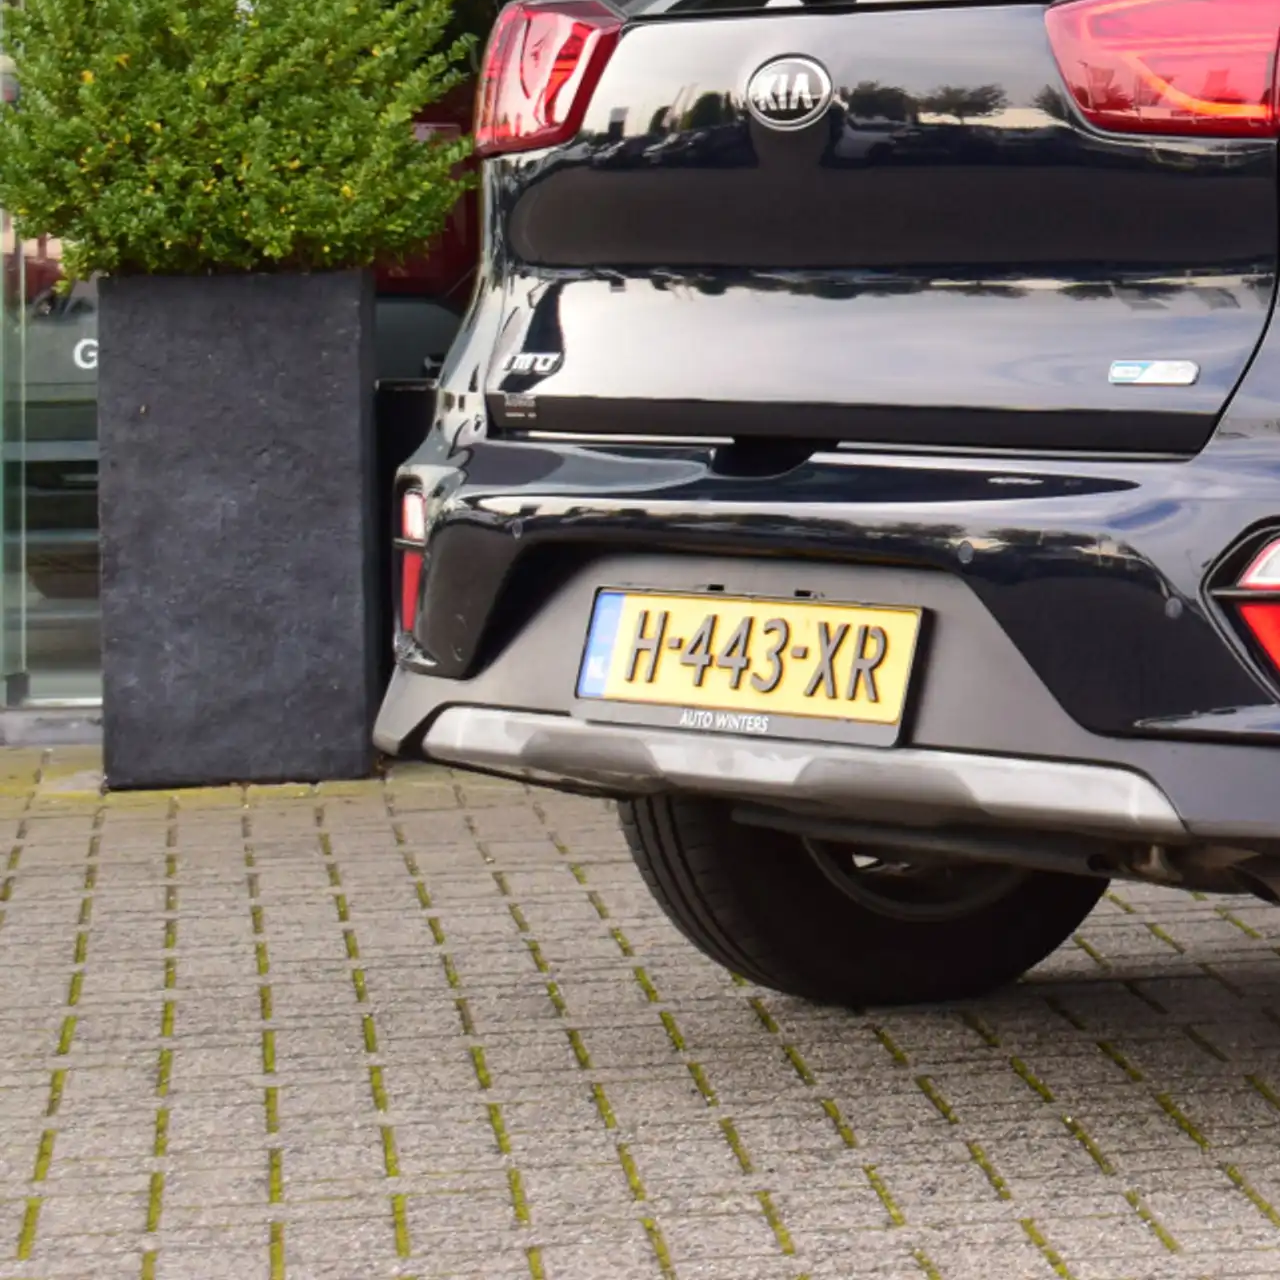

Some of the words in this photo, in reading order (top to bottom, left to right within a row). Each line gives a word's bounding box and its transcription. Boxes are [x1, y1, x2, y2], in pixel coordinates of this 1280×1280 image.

[624, 609, 889, 703] H-443-XR
[680, 707, 714, 729] AUTO
[715, 710, 770, 734] WINTERS
